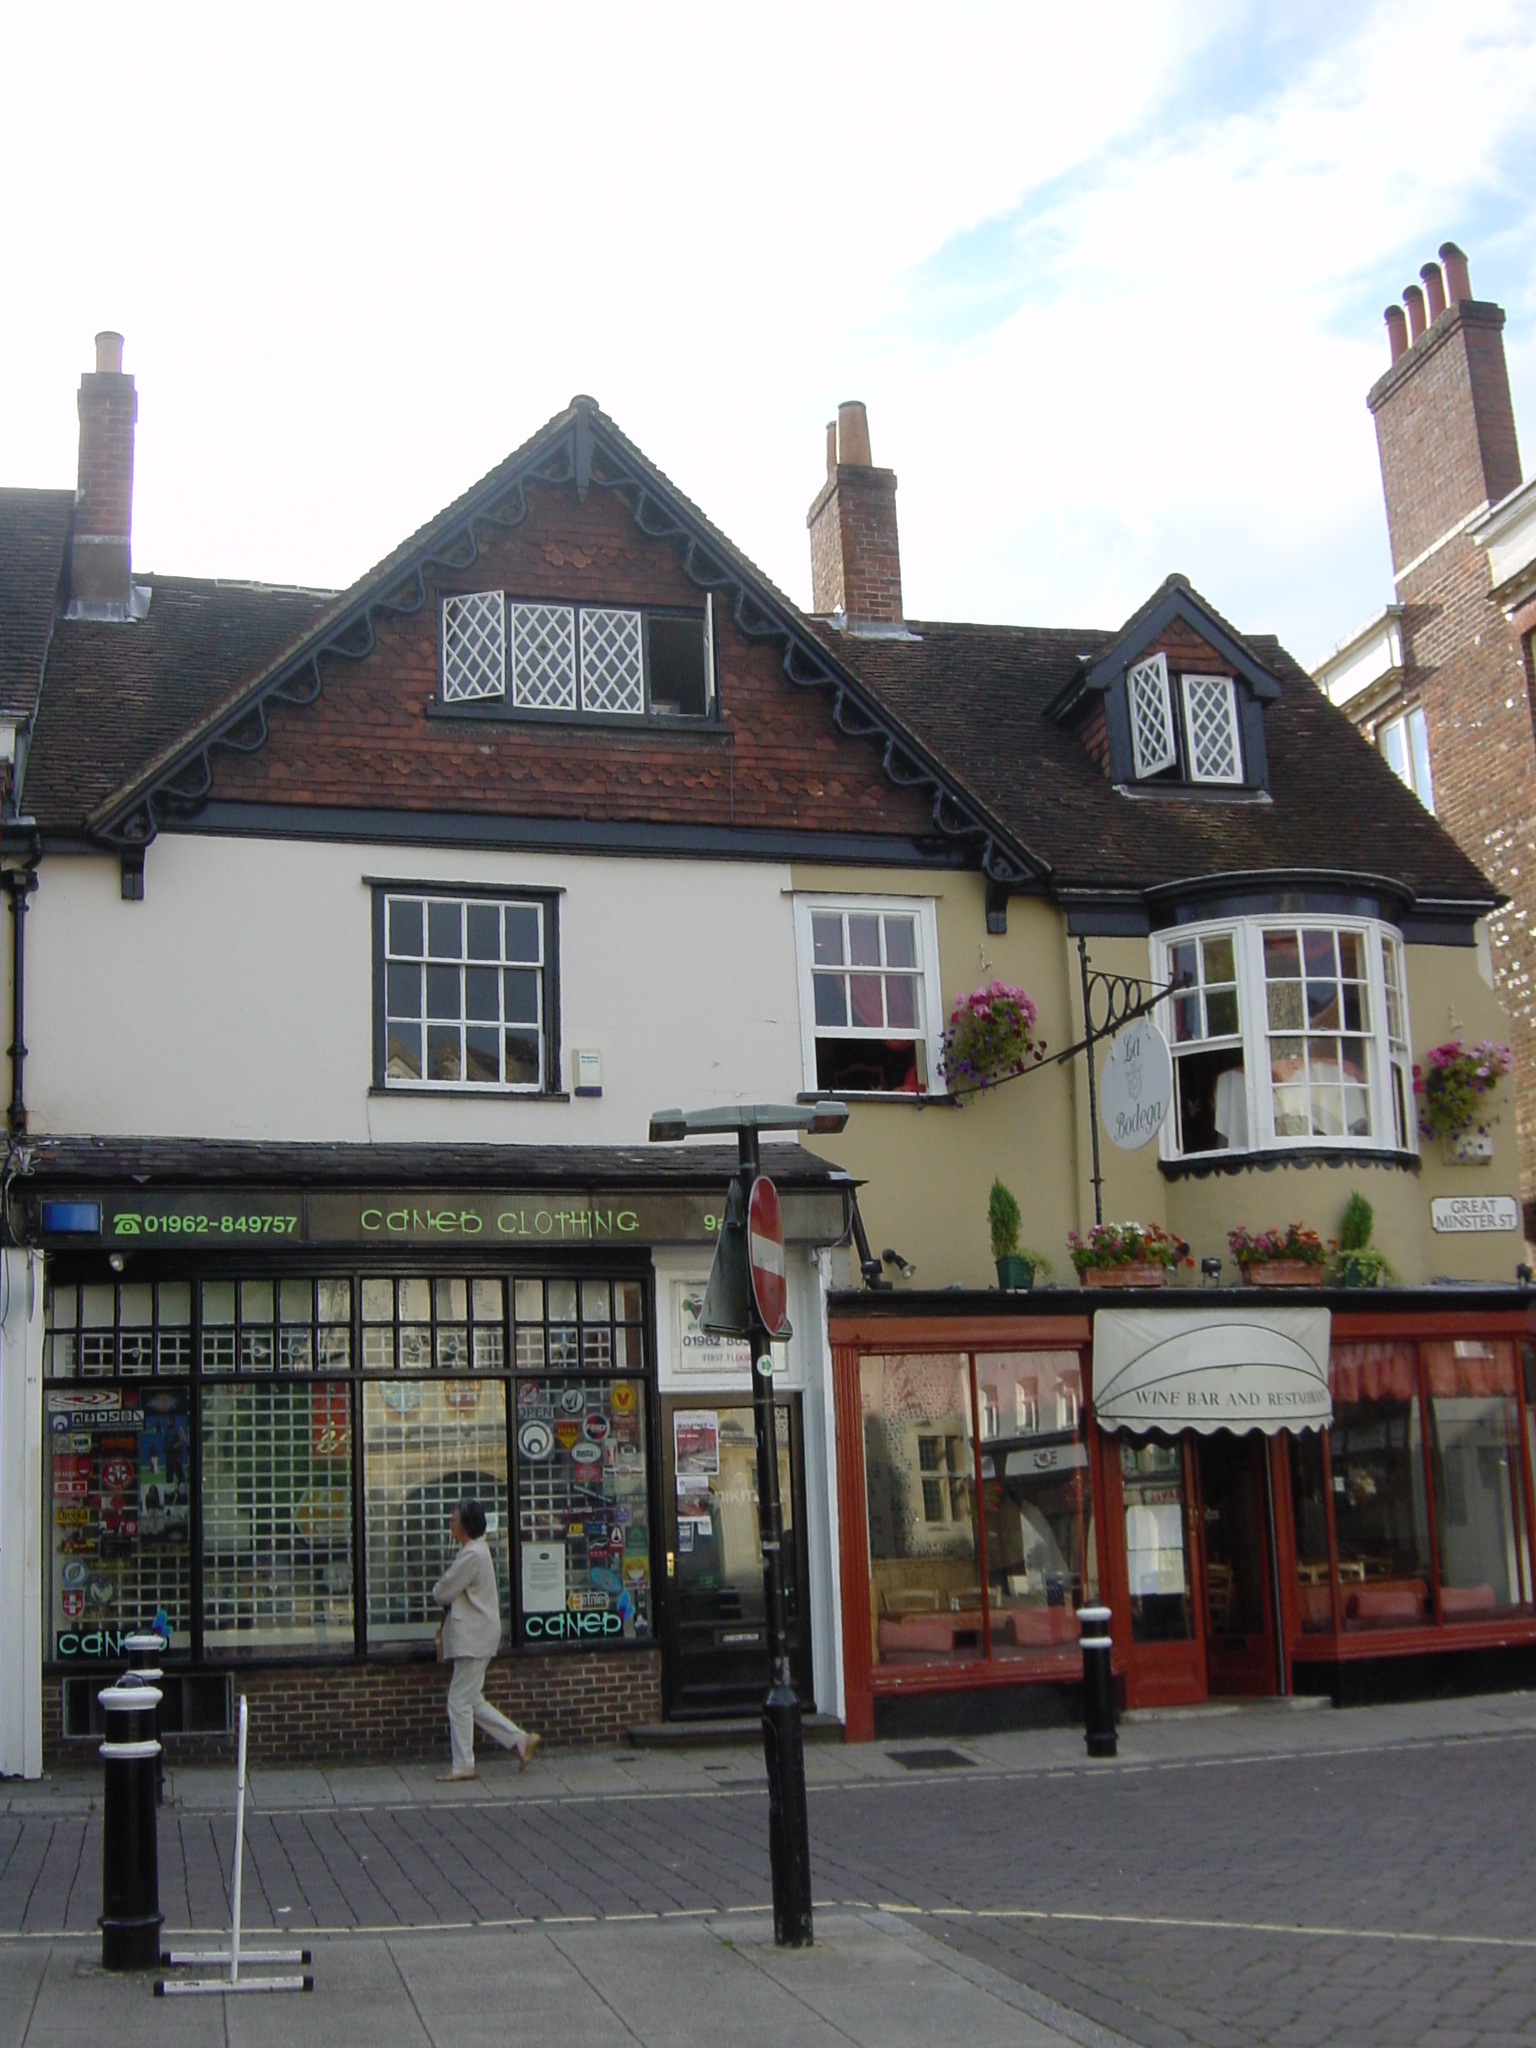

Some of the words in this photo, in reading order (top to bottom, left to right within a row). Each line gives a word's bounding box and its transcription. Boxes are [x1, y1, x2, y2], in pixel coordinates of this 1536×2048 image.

[1123, 1034, 1140, 1064] La
[1114, 1101, 1161, 1141] Bodega
[1451, 1199, 1497, 1214] GREAT
[144, 1215, 297, 1233] 01962-849757
[1437, 1214, 1497, 1229] MINSTER
[1500, 1214, 1513, 1228] ST
[683, 1335, 721, 1347] 01962
[1136, 1390, 1180, 1406] WINE
[1187, 1391, 1220, 1406] BAR
[1226, 1392, 1260, 1406] AND
[1268, 1390, 1326, 1406] RESTAURAN
